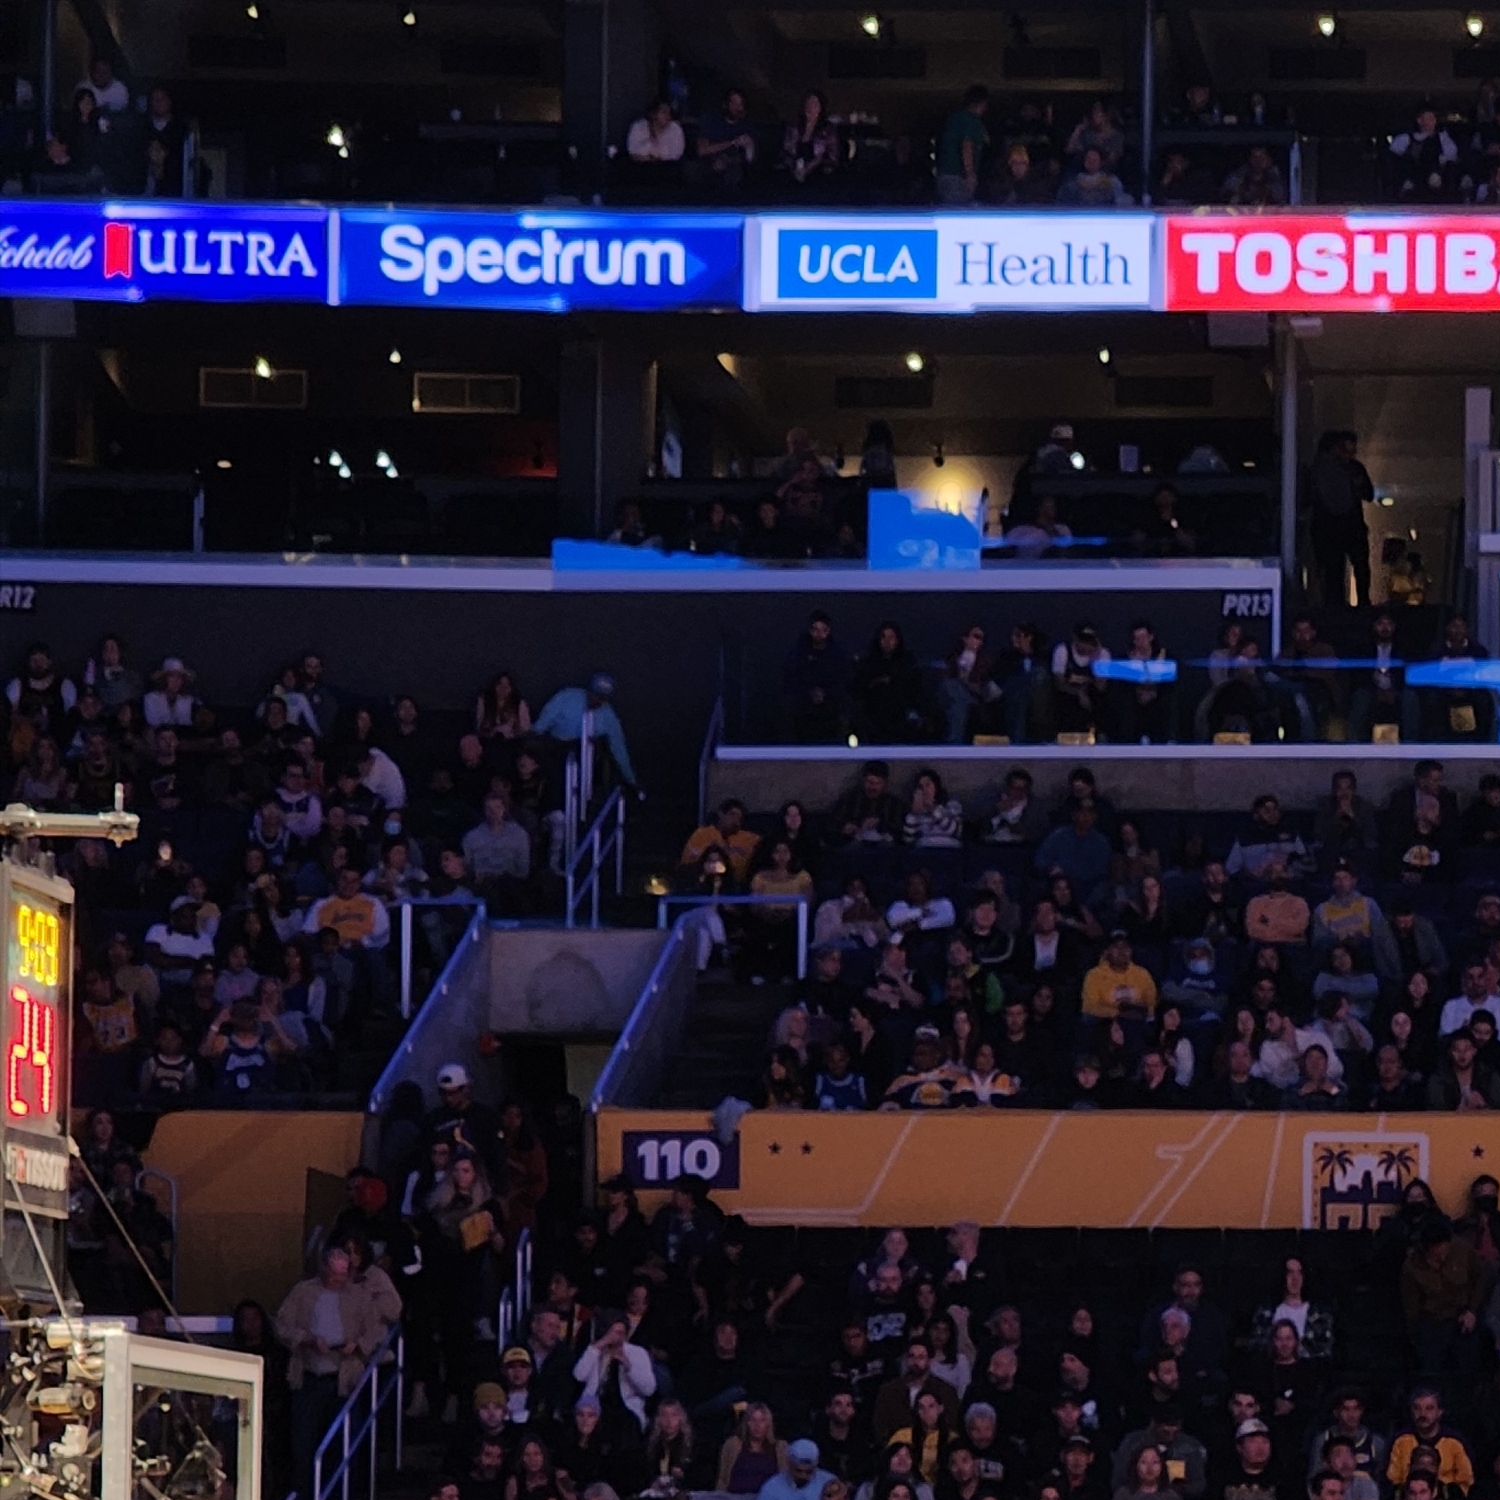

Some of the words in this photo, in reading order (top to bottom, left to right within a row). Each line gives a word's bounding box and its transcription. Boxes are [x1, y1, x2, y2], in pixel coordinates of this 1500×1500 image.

[138, 230, 318, 277] ULTRA
[380, 224, 687, 295] Spectrum
[797, 243, 919, 285] UCLA
[952, 241, 1133, 288] Health
[10, 986, 54, 1114] 24
[637, 1139, 721, 1181] 110
